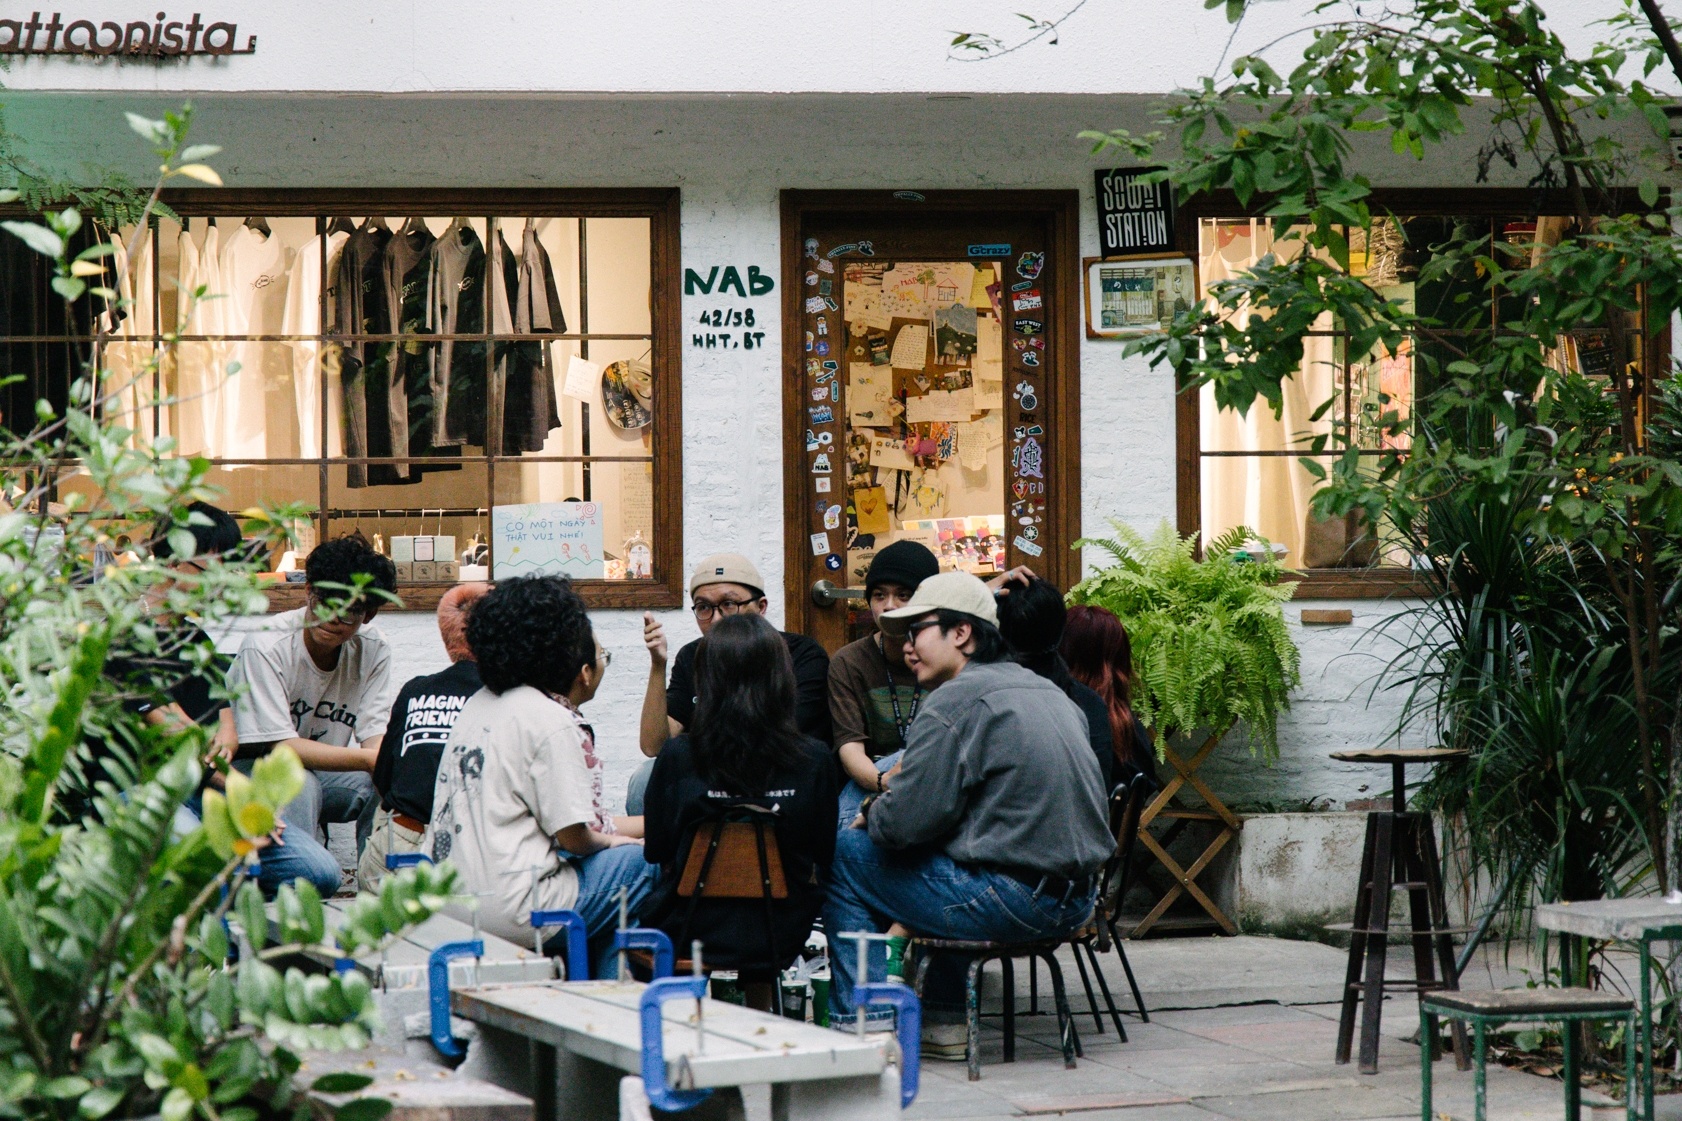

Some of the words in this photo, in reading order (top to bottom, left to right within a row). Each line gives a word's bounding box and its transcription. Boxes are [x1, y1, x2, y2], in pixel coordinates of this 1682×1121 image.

[1106, 210, 1167, 248] STATION
[684, 265, 775, 298] NAB
[1028, 320, 1042, 328] WEST
[692, 333, 738, 349] HHT,
[743, 332, 765, 350] BT
[506, 517, 524, 532] CÓ
[559, 517, 586, 528] NGÀY
[532, 533, 554, 541] VUI
[407, 694, 473, 713] IMAGIN
